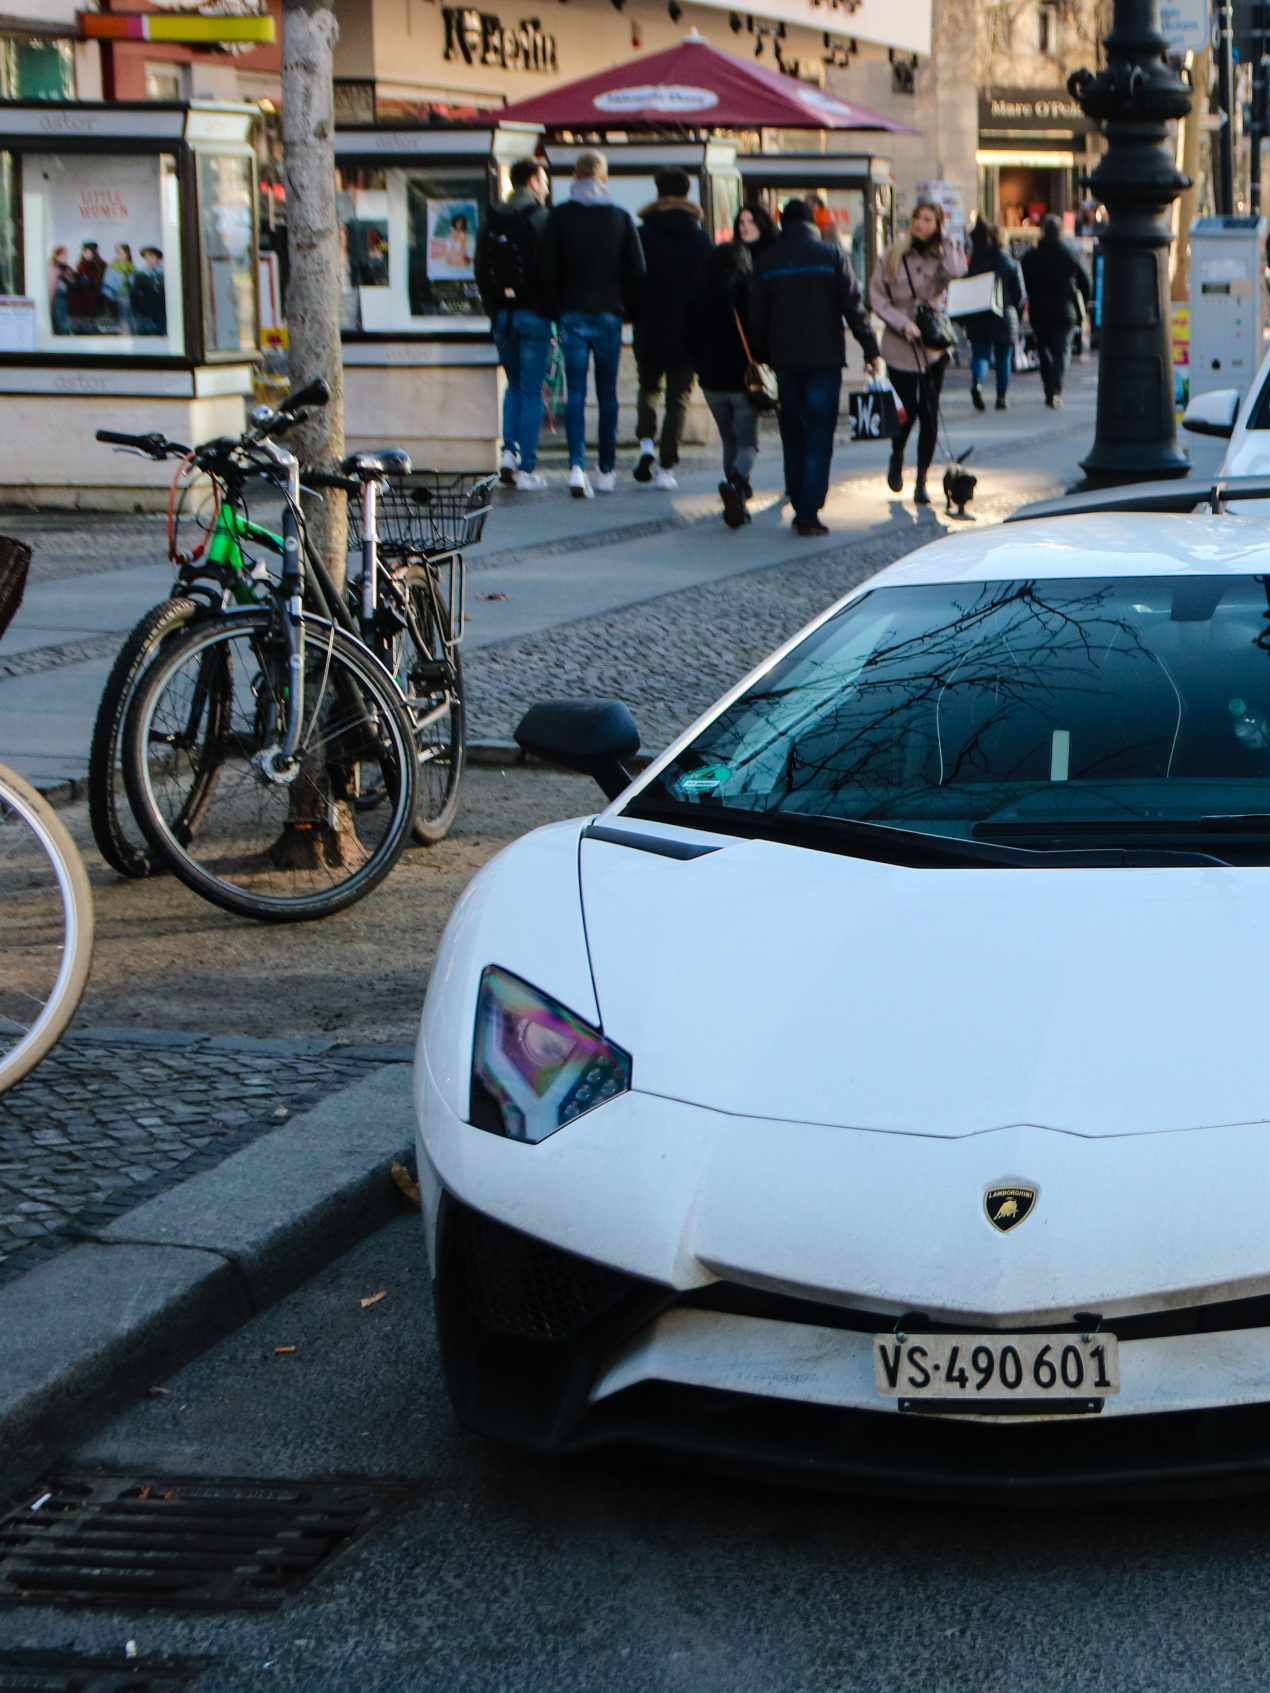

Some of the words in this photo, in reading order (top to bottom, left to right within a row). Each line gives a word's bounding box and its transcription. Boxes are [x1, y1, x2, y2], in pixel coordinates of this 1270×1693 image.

[991, 99, 1033, 117] Marc
[40, 110, 95, 131] astor
[80, 188, 122, 202] LITTLE
[78, 203, 130, 219] WOMEN
[702, 769, 717, 779] 4
[988, 1189, 1033, 1199] LAMBORGHINI
